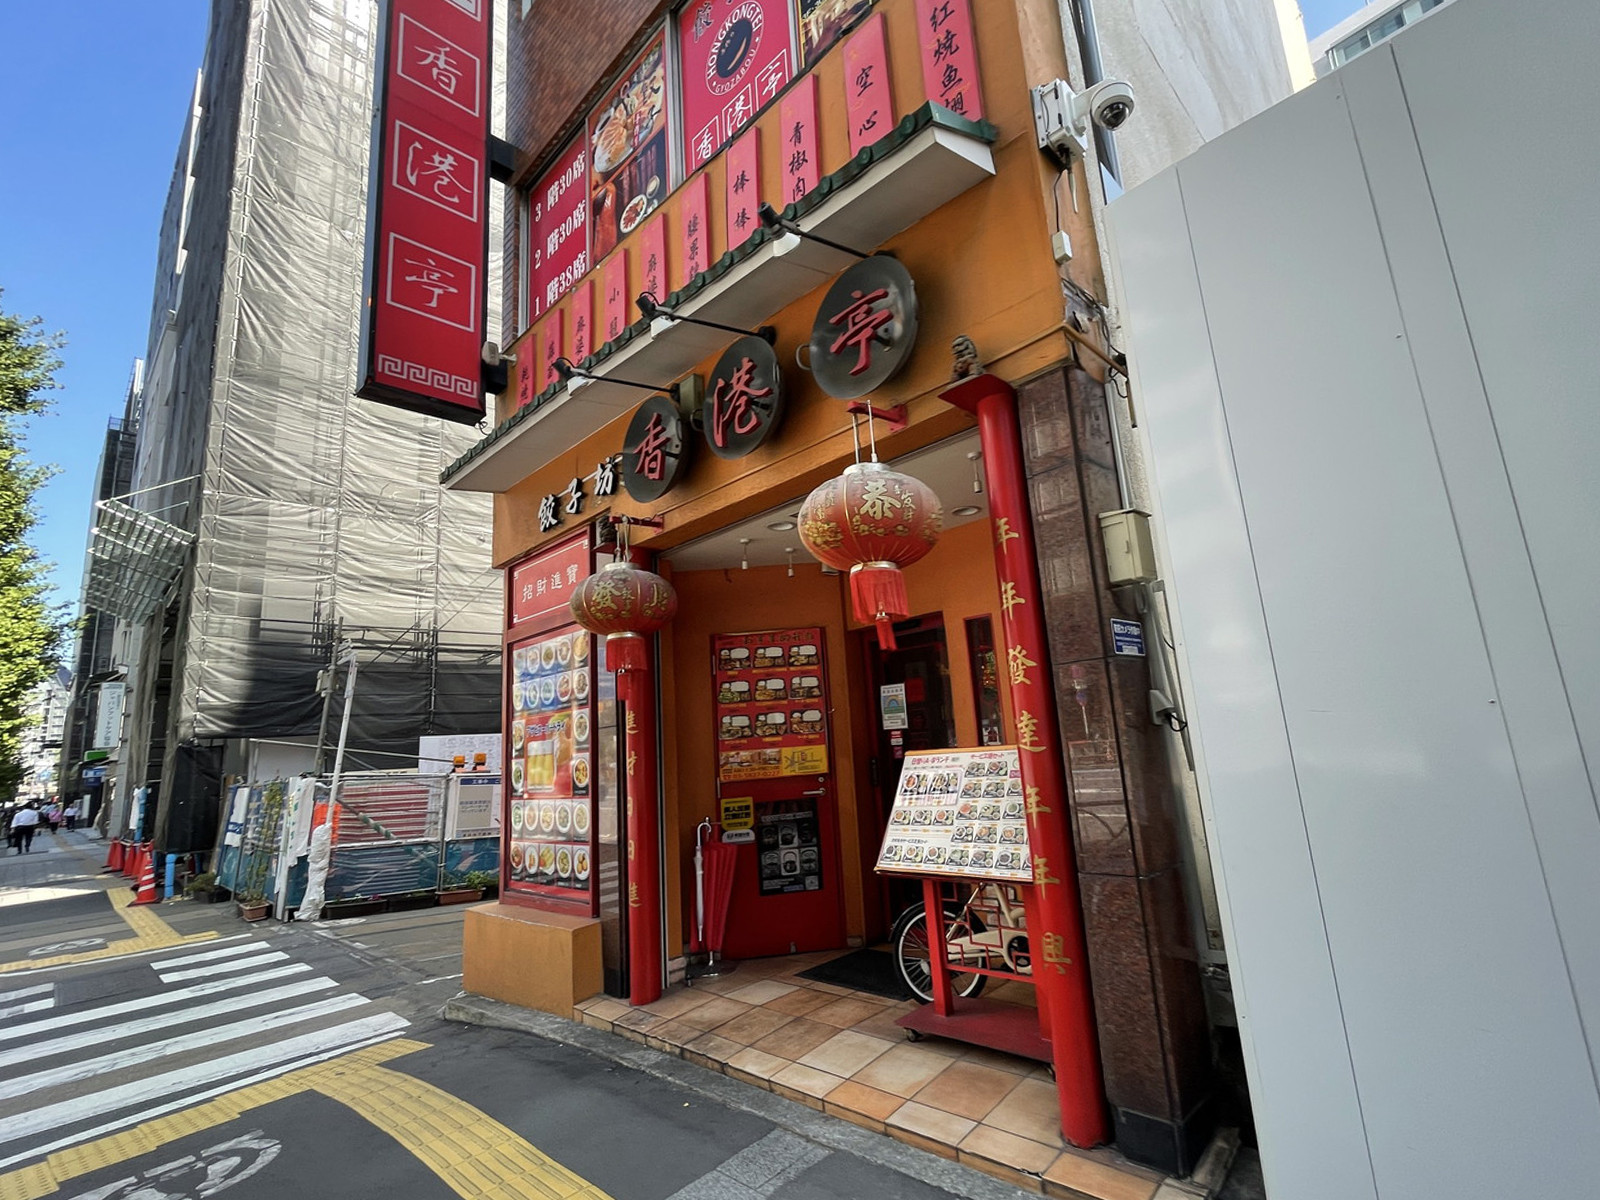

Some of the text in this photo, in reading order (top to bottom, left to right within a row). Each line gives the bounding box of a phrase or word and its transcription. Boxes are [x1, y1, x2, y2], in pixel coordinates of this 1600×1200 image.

[706, 3, 763, 80] HONGKONGTEI
[697, 61, 784, 160] 香港亭
[856, 65, 878, 137] 空心
[405, 46, 472, 309] 香港亭
[522, 564, 578, 603] 招財進寶
